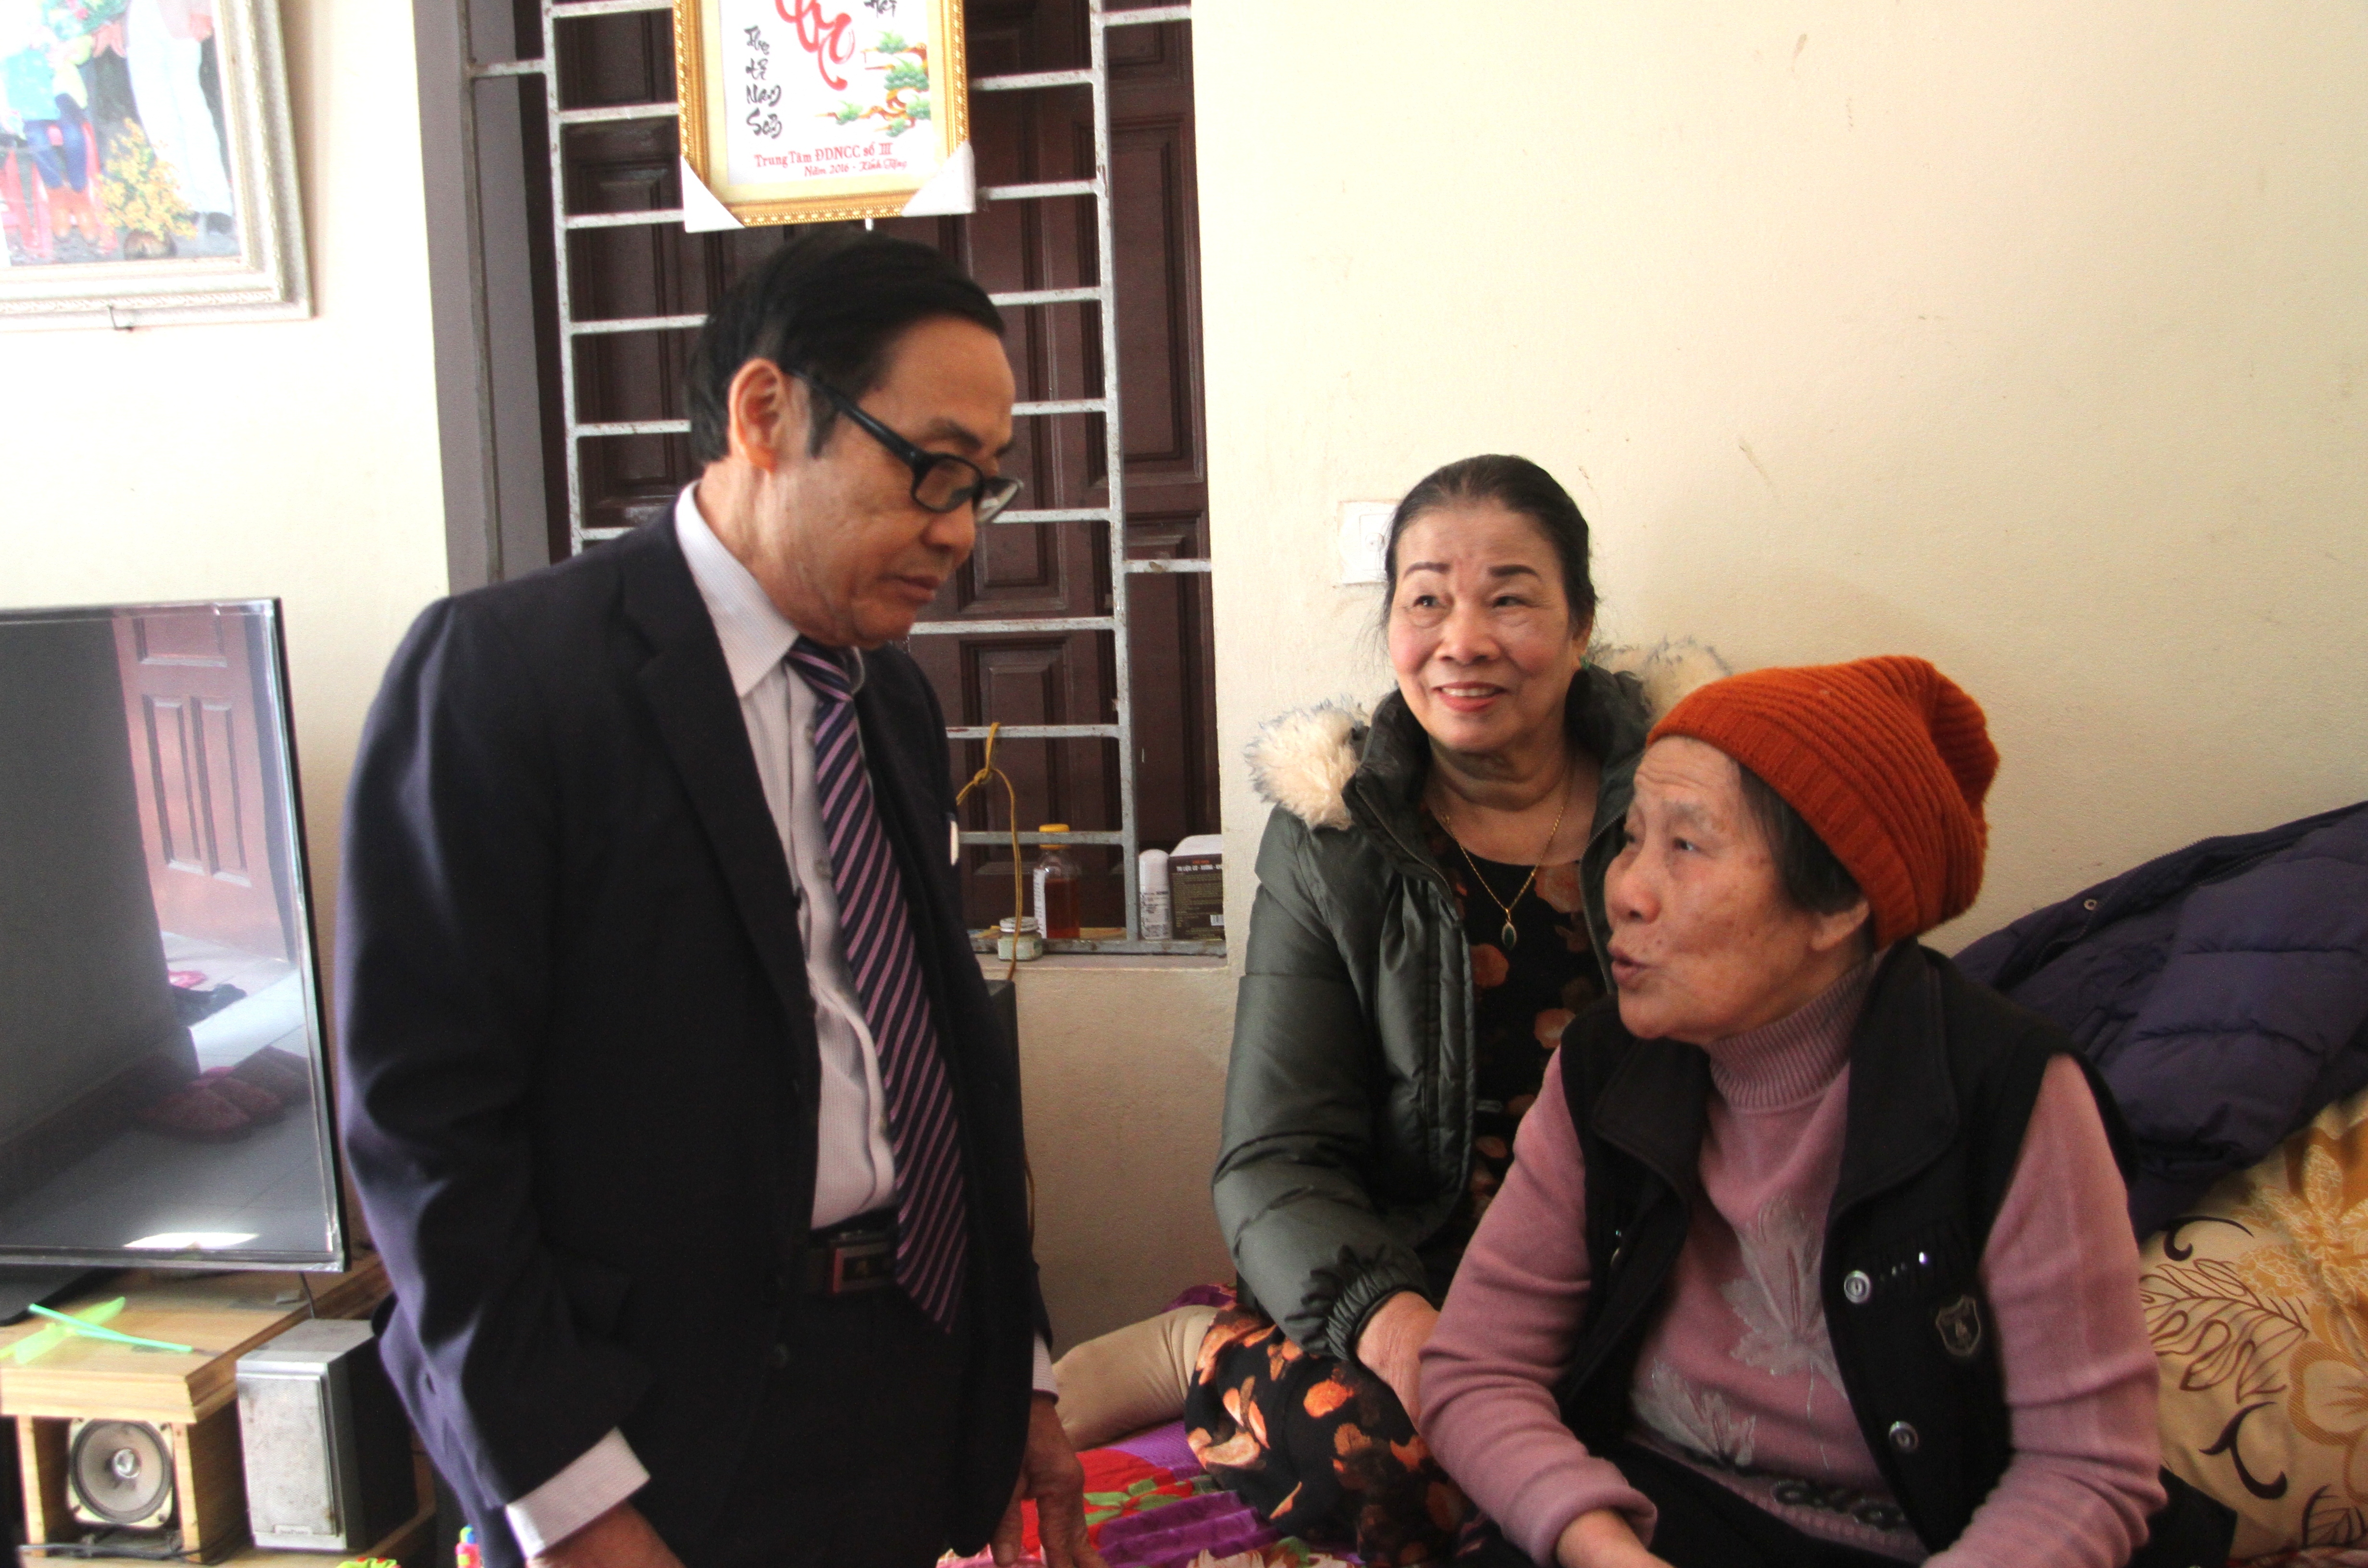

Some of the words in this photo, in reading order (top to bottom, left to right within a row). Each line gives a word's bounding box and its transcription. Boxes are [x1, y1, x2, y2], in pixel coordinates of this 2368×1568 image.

[754, 154, 788, 168] Trung
[788, 150, 812, 164] Tâm
[814, 145, 860, 161] ĐDNCC
[863, 141, 875, 157] số
[878, 142, 893, 155] III
[804, 165, 827, 177] Năm
[829, 163, 850, 174] 2016
